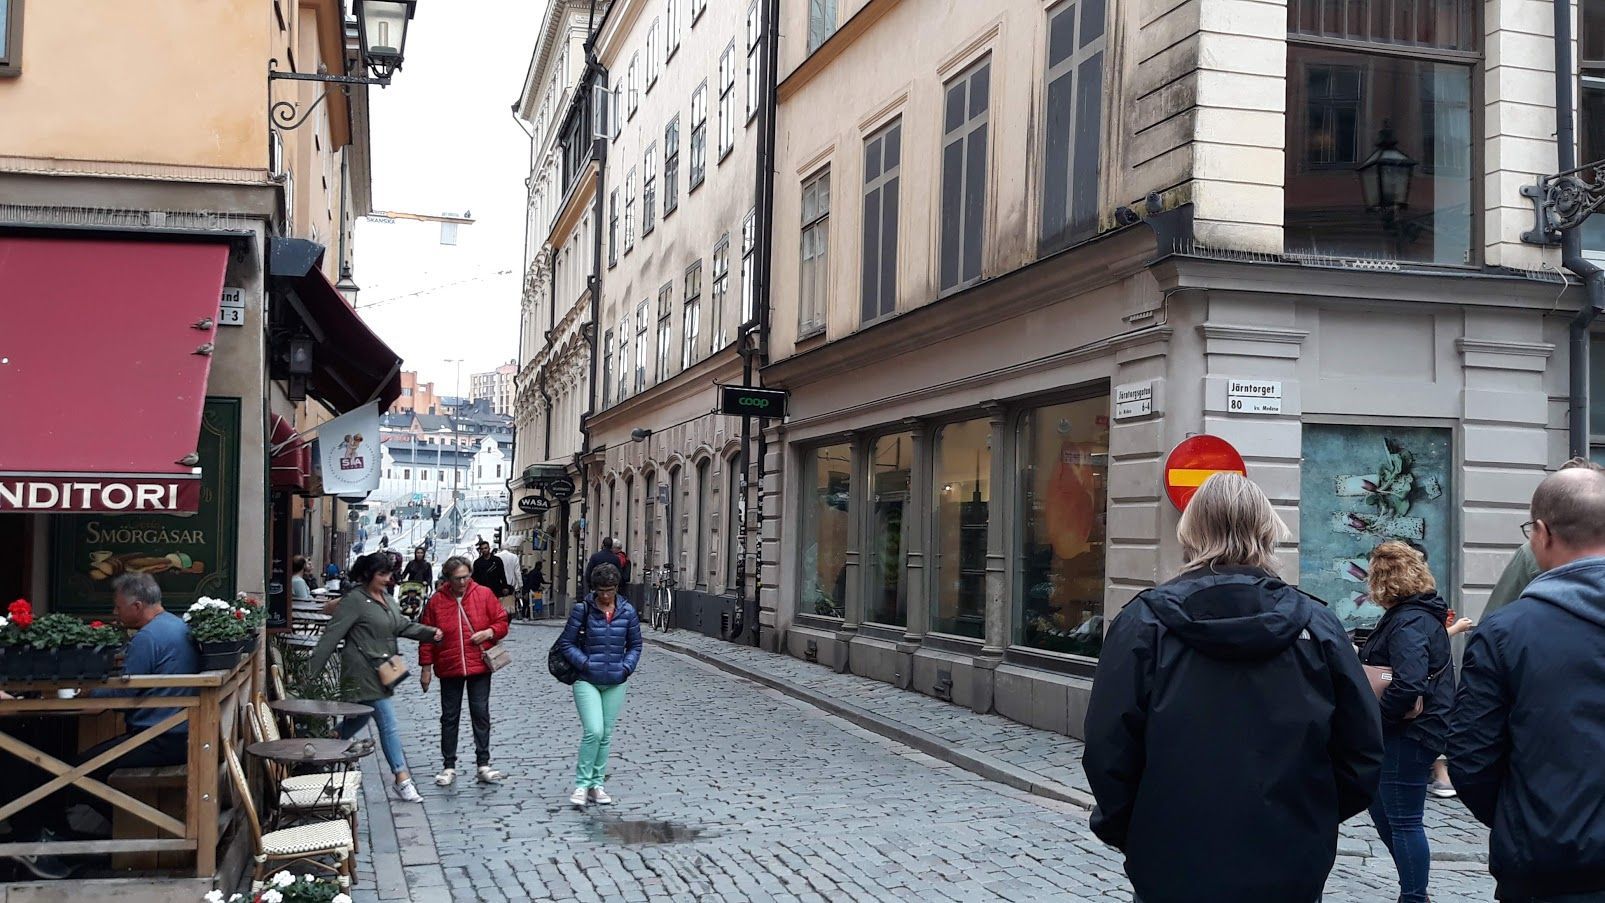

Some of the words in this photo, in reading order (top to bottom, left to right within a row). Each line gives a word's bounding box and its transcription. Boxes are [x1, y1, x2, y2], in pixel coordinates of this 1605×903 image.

[366, 217, 396, 225] SKANSKA
[220, 309, 239, 321] 1-3
[1231, 382, 1275, 396] Järntorget
[738, 397, 769, 408] coop
[1231, 399, 1243, 410] 80
[342, 457, 362, 467] SIA
[0, 481, 179, 510] NDITORI
[521, 498, 549, 508] WASA
